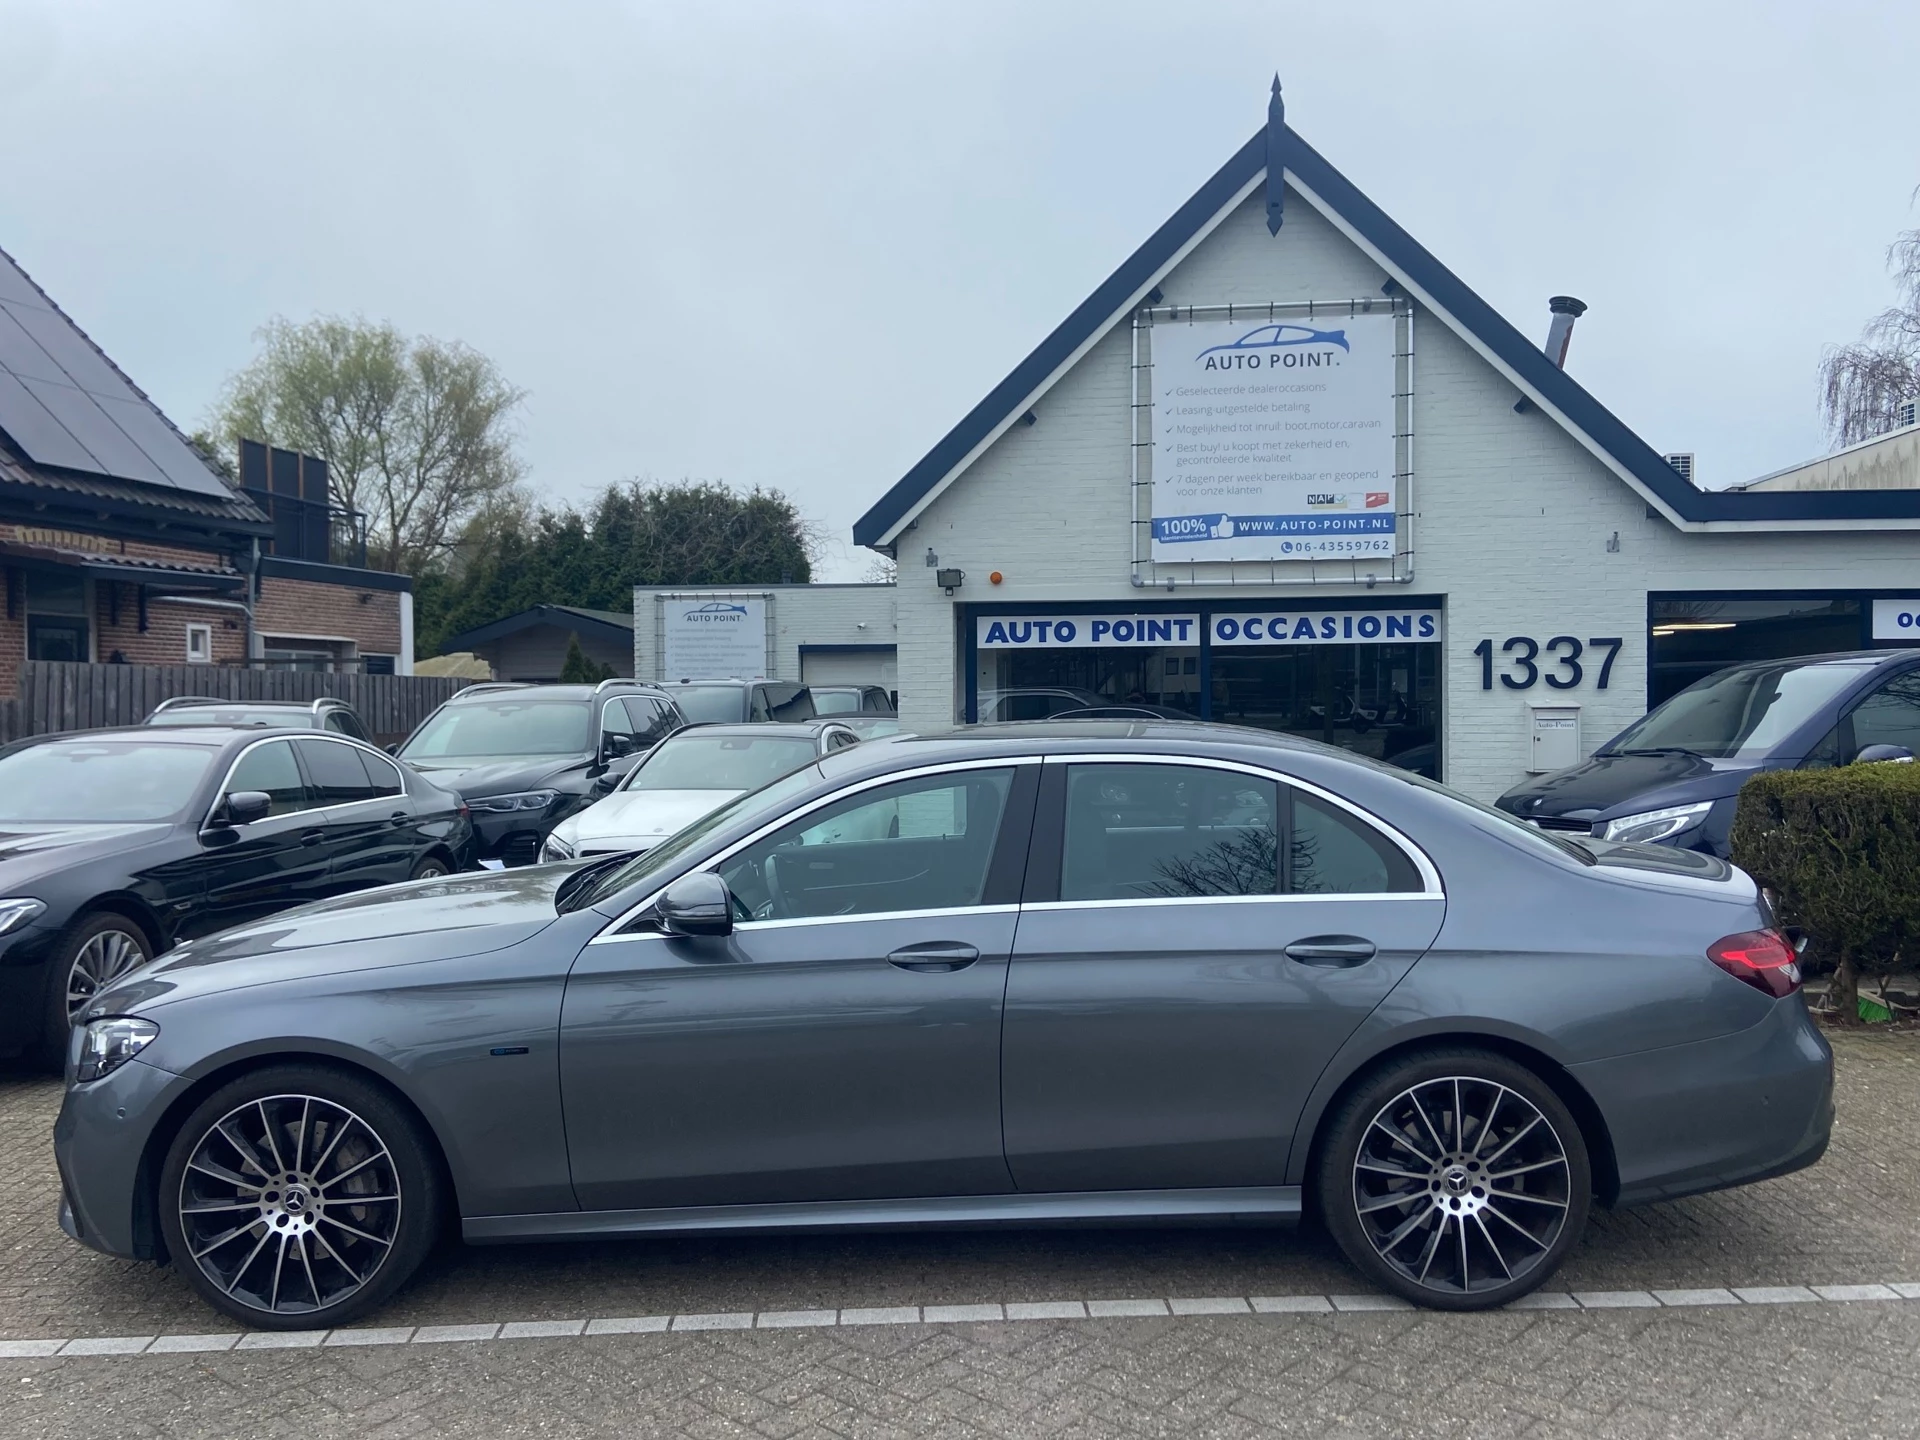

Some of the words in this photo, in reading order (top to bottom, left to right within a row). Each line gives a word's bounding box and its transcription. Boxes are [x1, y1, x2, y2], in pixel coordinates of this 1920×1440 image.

[1204, 354, 1261, 371] AUTO
[1269, 351, 1341, 369] POINT.
[1176, 386, 1246, 397] Geselecteerde
[1249, 383, 1327, 394] dealeroccasions
[1176, 405, 1269, 417] Leasing-uitgestelde
[1271, 402, 1311, 414] betaling
[1176, 422, 1237, 436] Mogelijkheid
[1239, 423, 1253, 433] tot
[1255, 421, 1282, 432] inruil:
[1176, 443, 1198, 453] Best
[1200, 442, 1221, 455] buy!
[1223, 444, 1230, 452] u
[1232, 441, 1260, 454] koopt
[1262, 440, 1282, 450] met
[1284, 438, 1332, 449] zekerheid
[1176, 454, 1251, 467] gecontroleerde
[1252, 453, 1292, 463] kwaliteit
[1177, 475, 1183, 484] 7
[1185, 473, 1215, 486] dagen
[1217, 474, 1235, 486] per
[1236, 471, 1262, 482] week
[1264, 469, 1316, 481] bereikbaar
[1319, 471, 1332, 480] en
[1334, 468, 1379, 482] geopend
[1176, 488, 1198, 496] voor
[1200, 486, 1225, 495] onze
[1226, 485, 1263, 495] klanten
[1307, 494, 1334, 505] NAP
[1161, 518, 1207, 535] 100%
[1239, 519, 1389, 532] WWW.AUTO-POINT.NL
[1295, 540, 1390, 552] 06-43559762
[686, 614, 711, 622] AUTO
[985, 620, 1077, 643] AUTO
[1091, 619, 1194, 642] POINT
[1215, 614, 1437, 641] OCCASIONS
[1473, 635, 1623, 690] 1337
